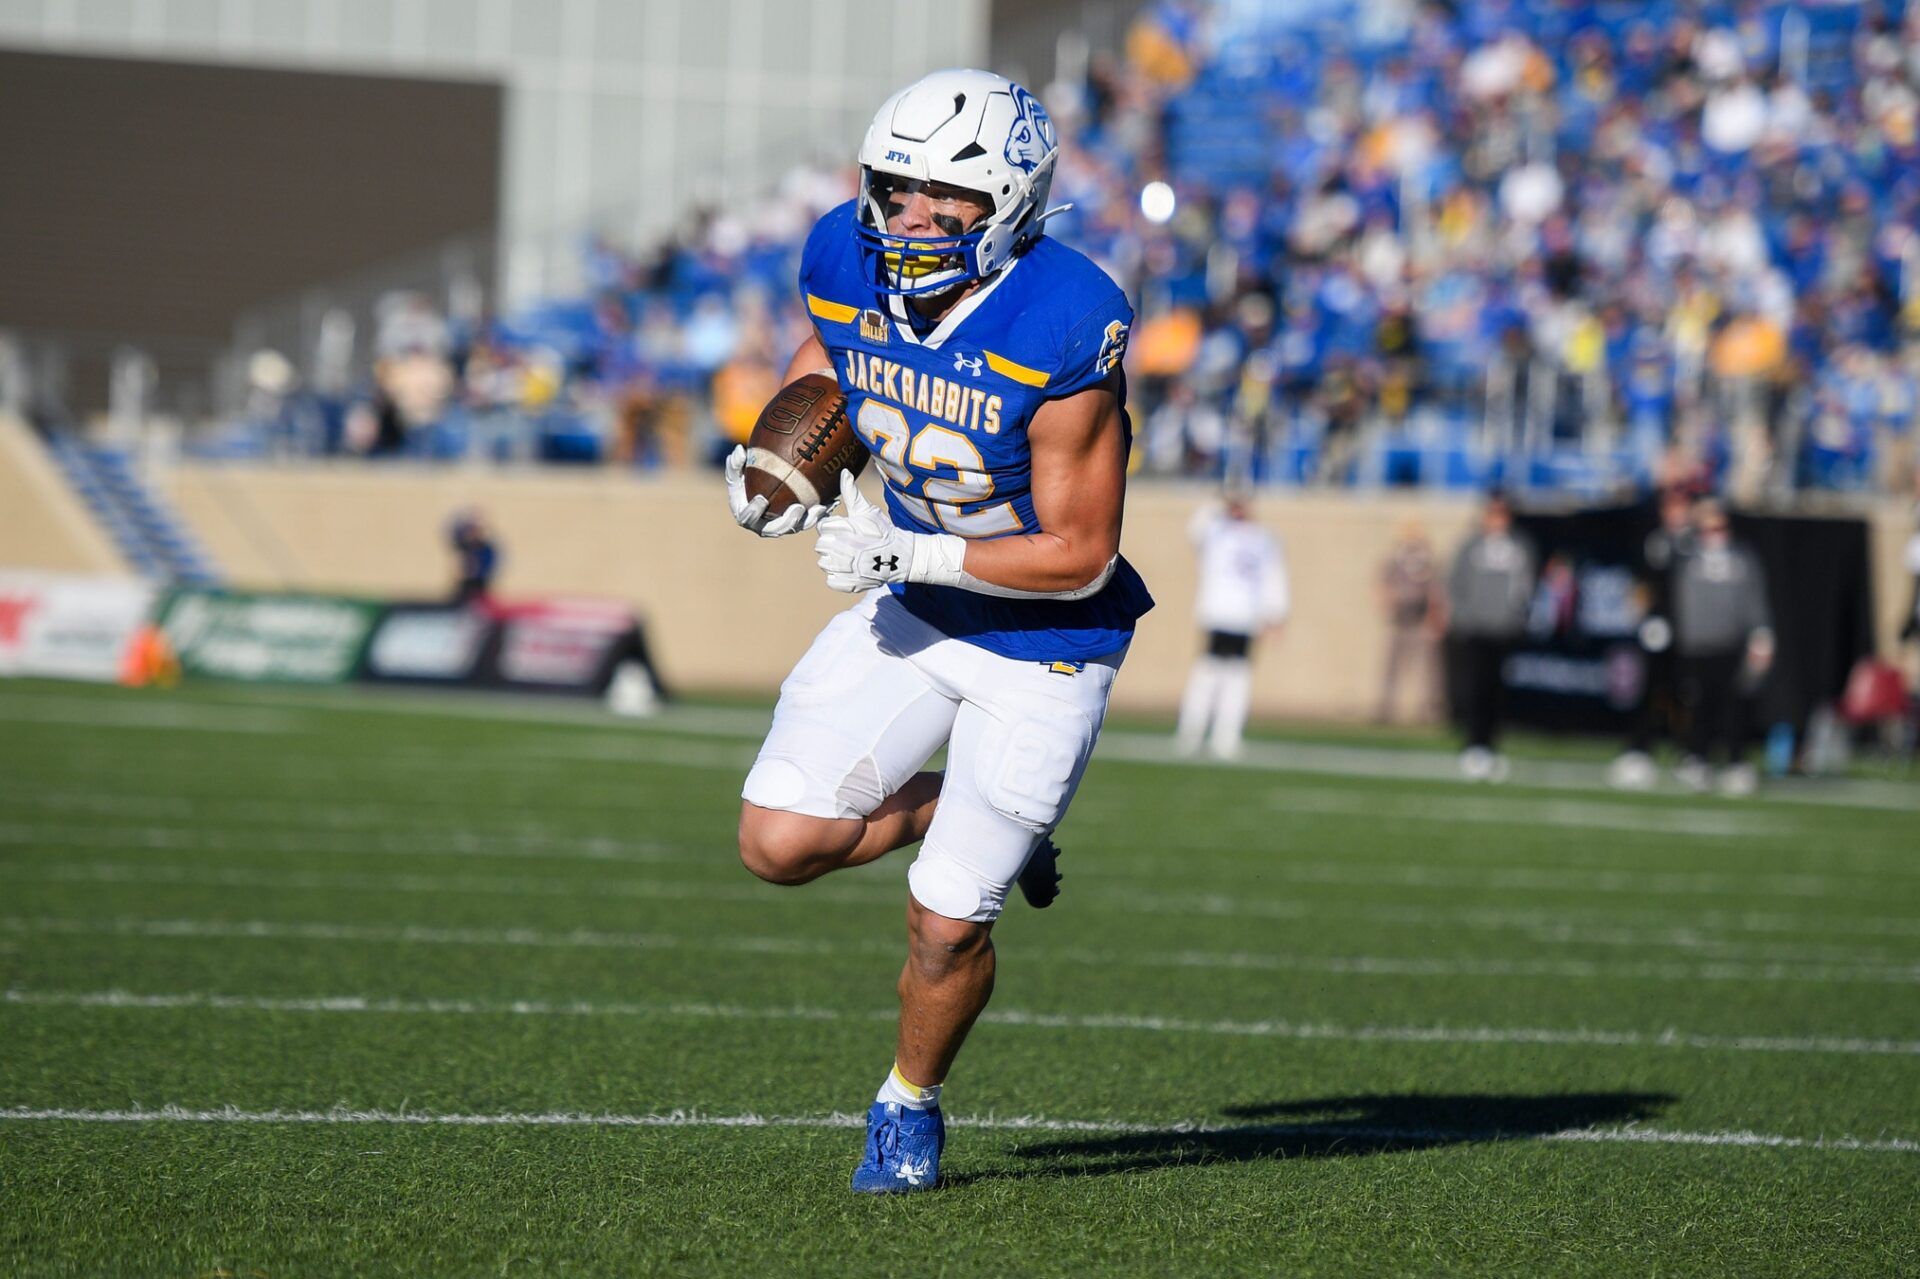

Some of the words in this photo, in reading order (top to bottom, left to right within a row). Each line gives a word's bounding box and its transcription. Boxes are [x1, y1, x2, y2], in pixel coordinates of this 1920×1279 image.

[885, 150, 911, 164] JFPA
[846, 350, 1002, 435] JACKRABBITS
[857, 397, 1024, 540] 22
